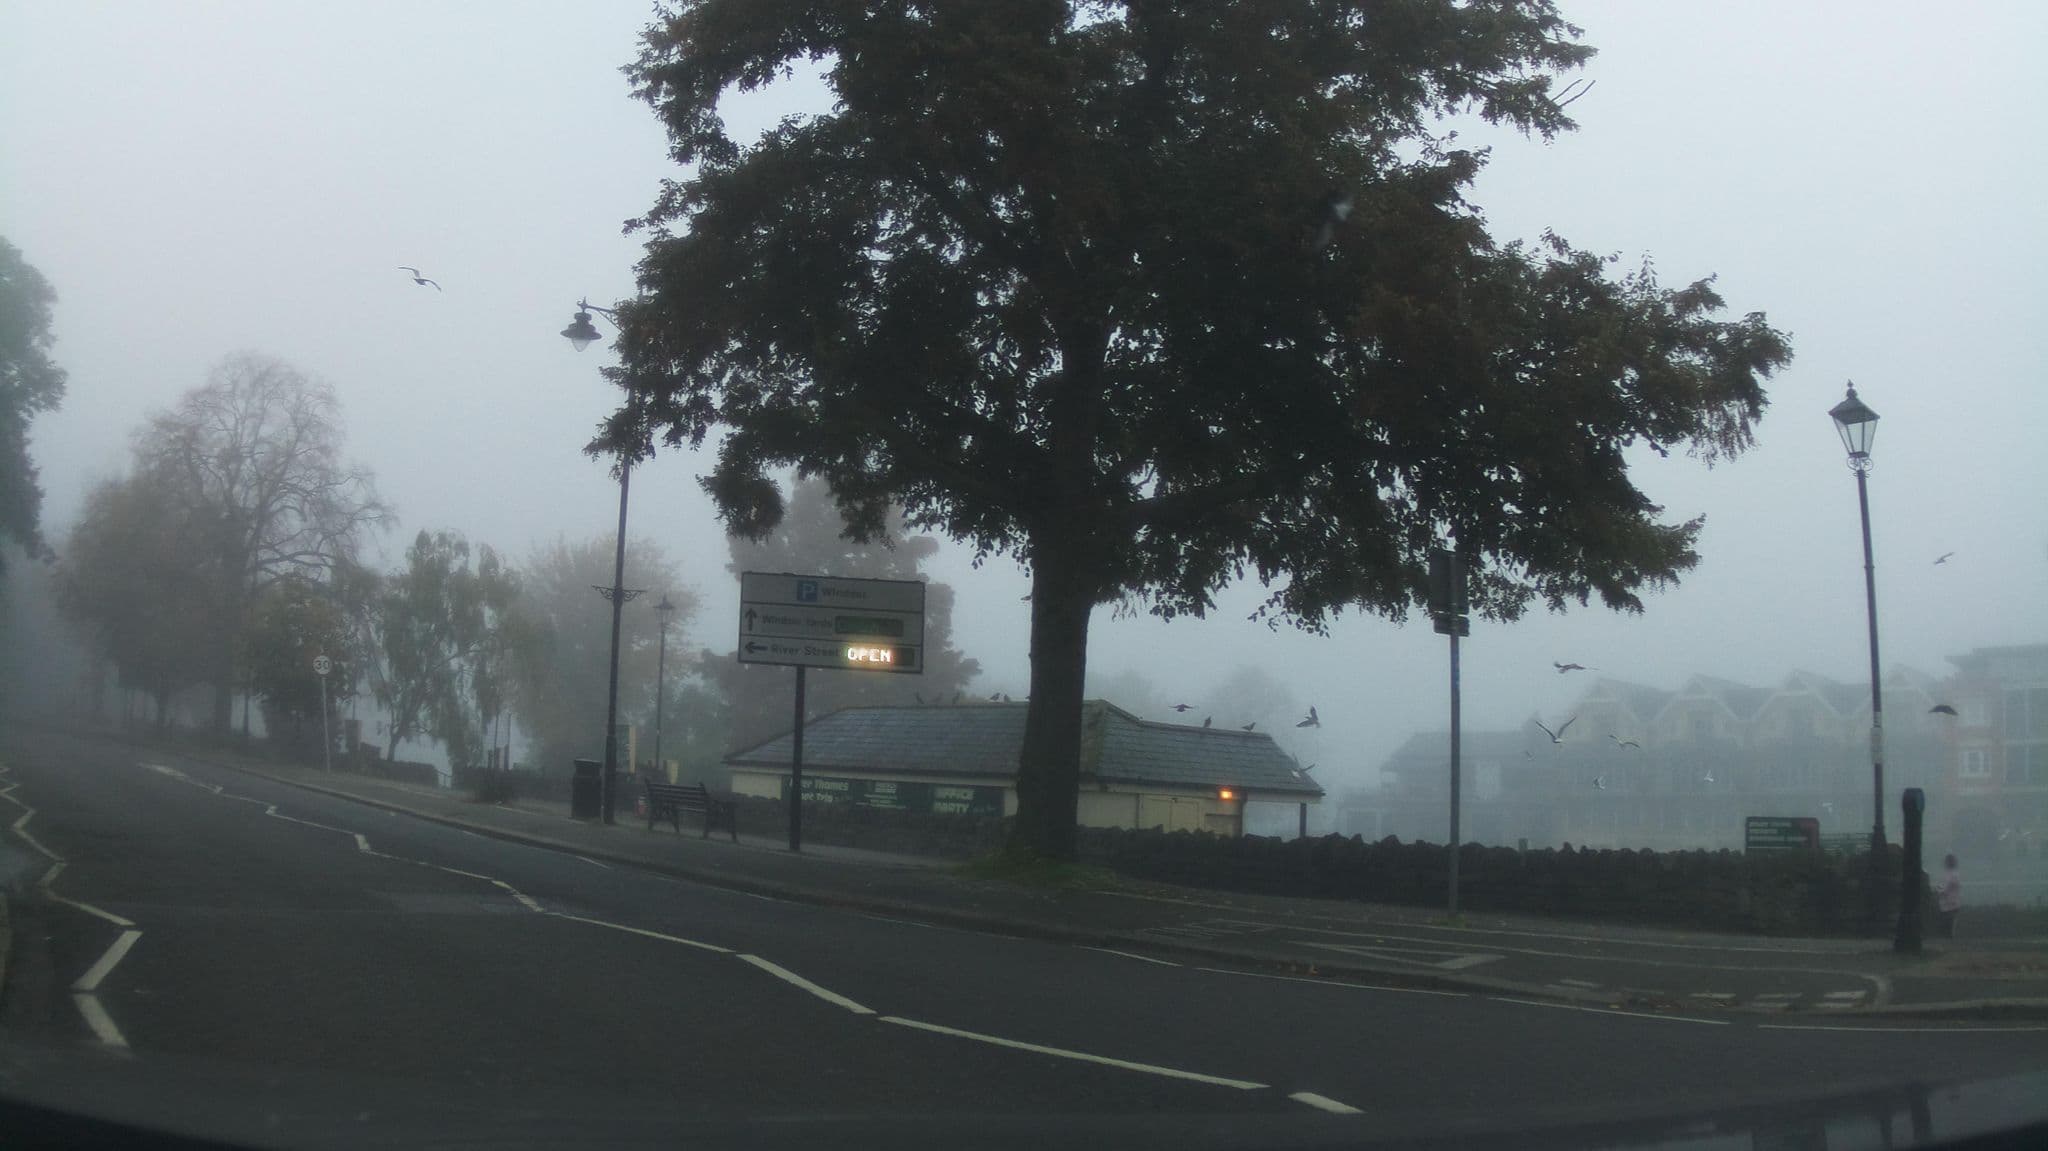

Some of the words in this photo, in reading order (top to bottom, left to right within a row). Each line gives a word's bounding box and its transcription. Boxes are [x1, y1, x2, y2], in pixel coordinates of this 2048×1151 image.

[770, 643, 800, 657] River
[804, 645, 840, 658] Street
[847, 647, 891, 663] OPEN
[315, 660, 330, 670] 30
